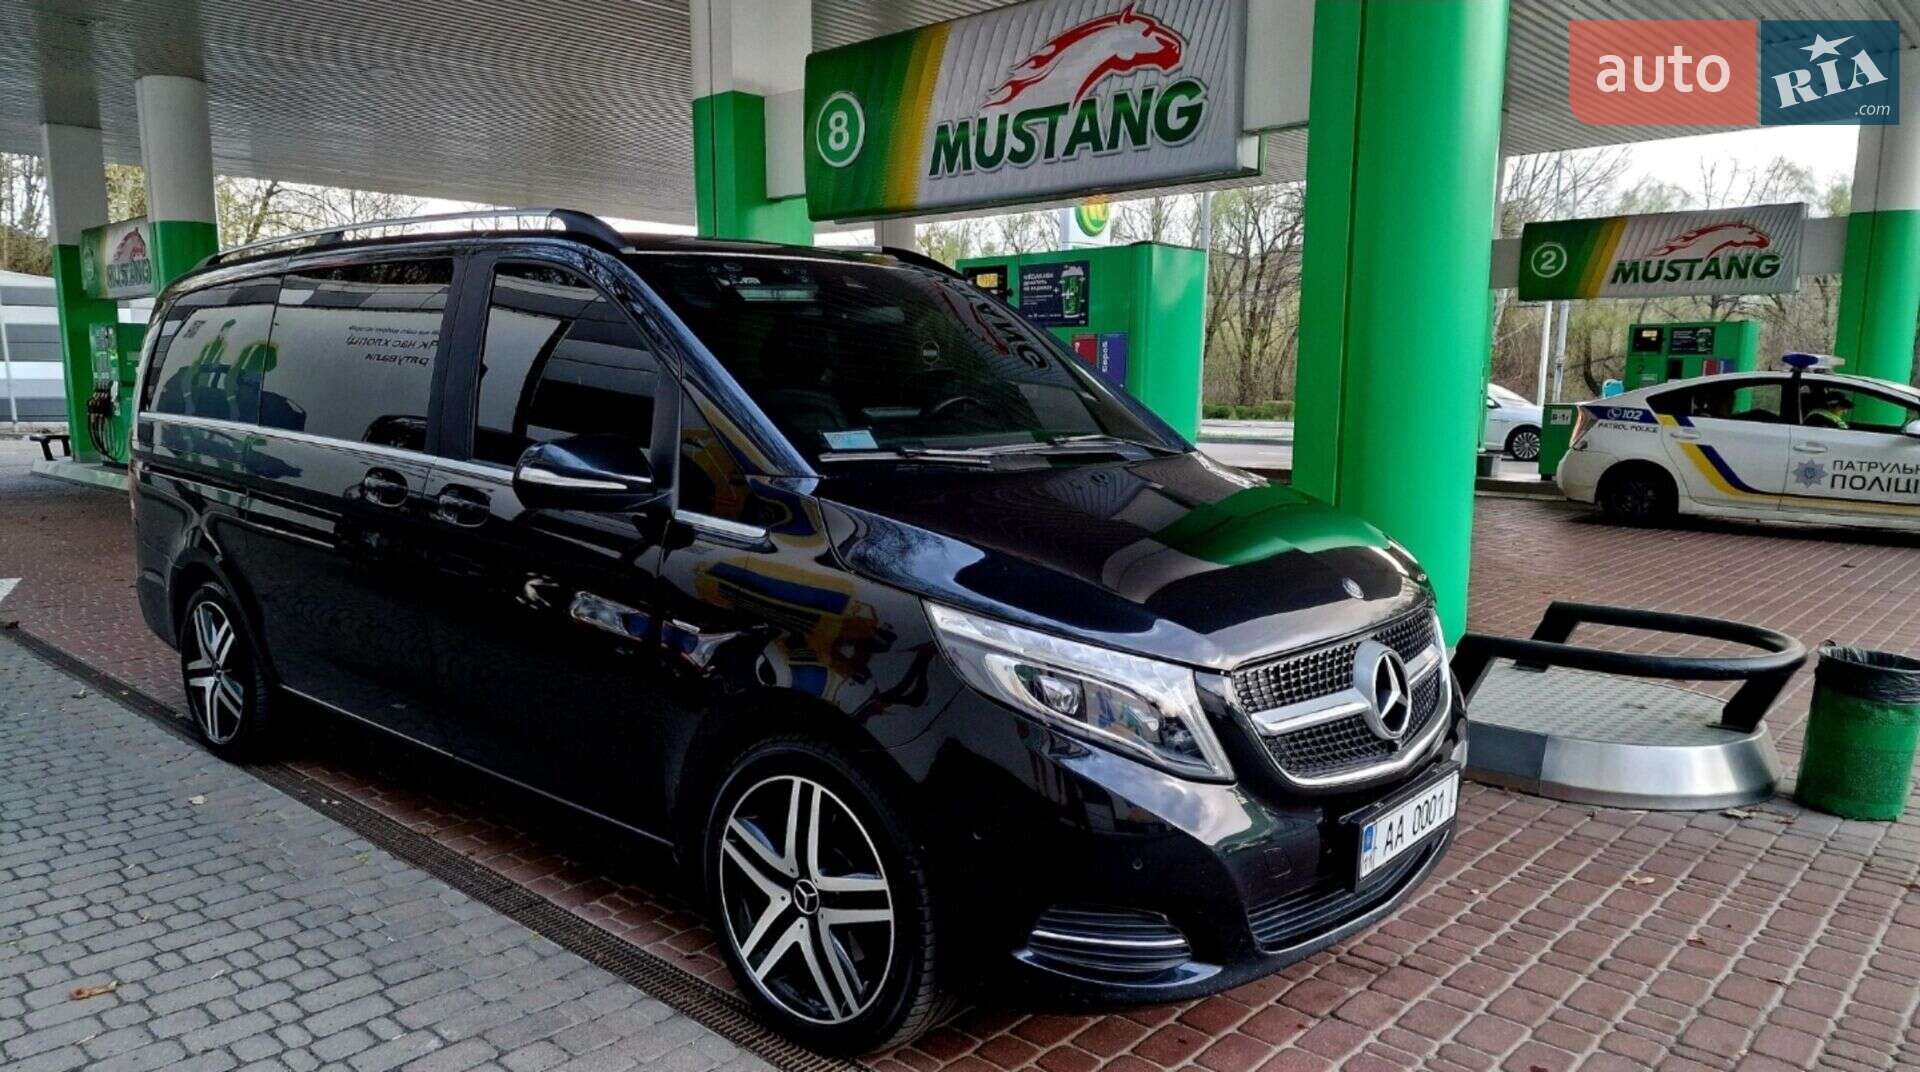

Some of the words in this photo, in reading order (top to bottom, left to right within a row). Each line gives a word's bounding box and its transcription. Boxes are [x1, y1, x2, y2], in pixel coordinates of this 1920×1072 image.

[827, 111, 851, 152] 8
[928, 79, 1208, 178] MUSTANG
[106, 258, 152, 288] MUSTANG
[1541, 250, 1557, 271] 2
[1610, 253, 1783, 285] MUSTANG
[1622, 409, 1643, 420] 102
[1630, 425, 1659, 433] POLICE
[1412, 789, 1445, 836] 0001
